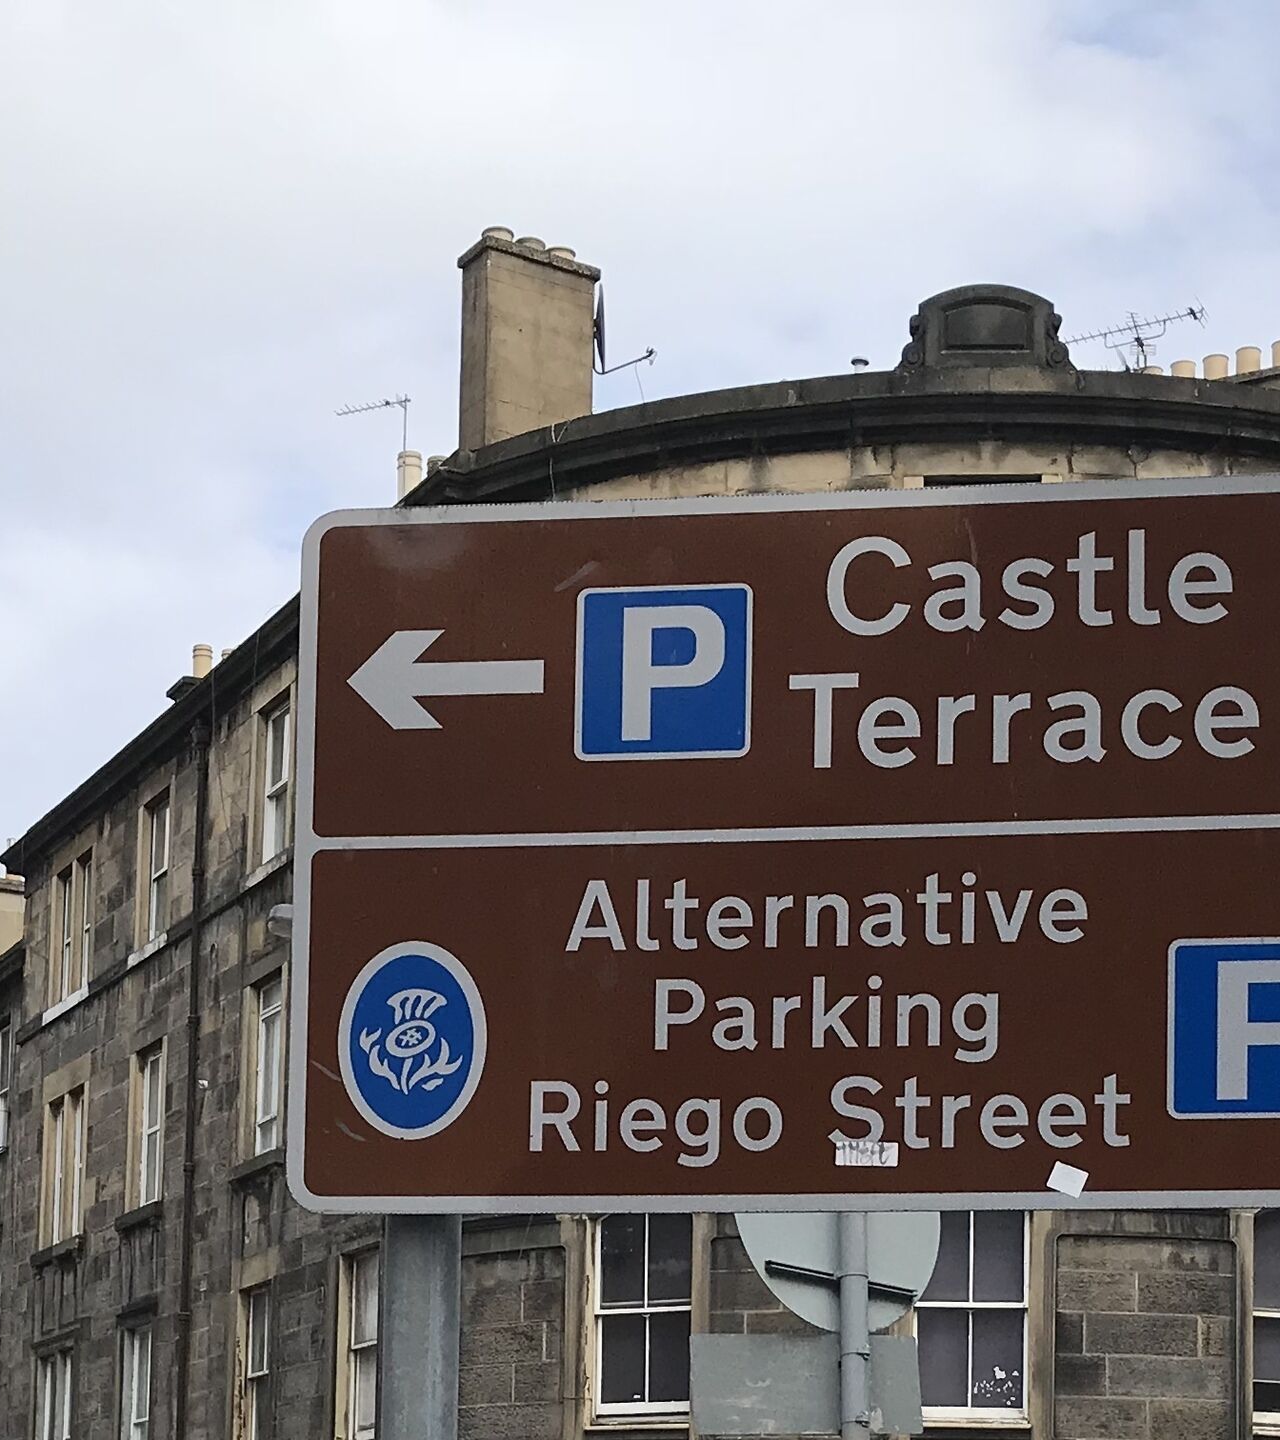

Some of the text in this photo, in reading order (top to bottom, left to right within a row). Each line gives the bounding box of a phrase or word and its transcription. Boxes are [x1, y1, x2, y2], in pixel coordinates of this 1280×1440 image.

[825, 528, 1234, 637] Castle
[620, 605, 726, 742] P
[788, 671, 1259, 770] Terrace
[564, 870, 1089, 953] Alternative
[653, 974, 1001, 1063] Parking
[529, 1071, 1131, 1168] Riego Street
